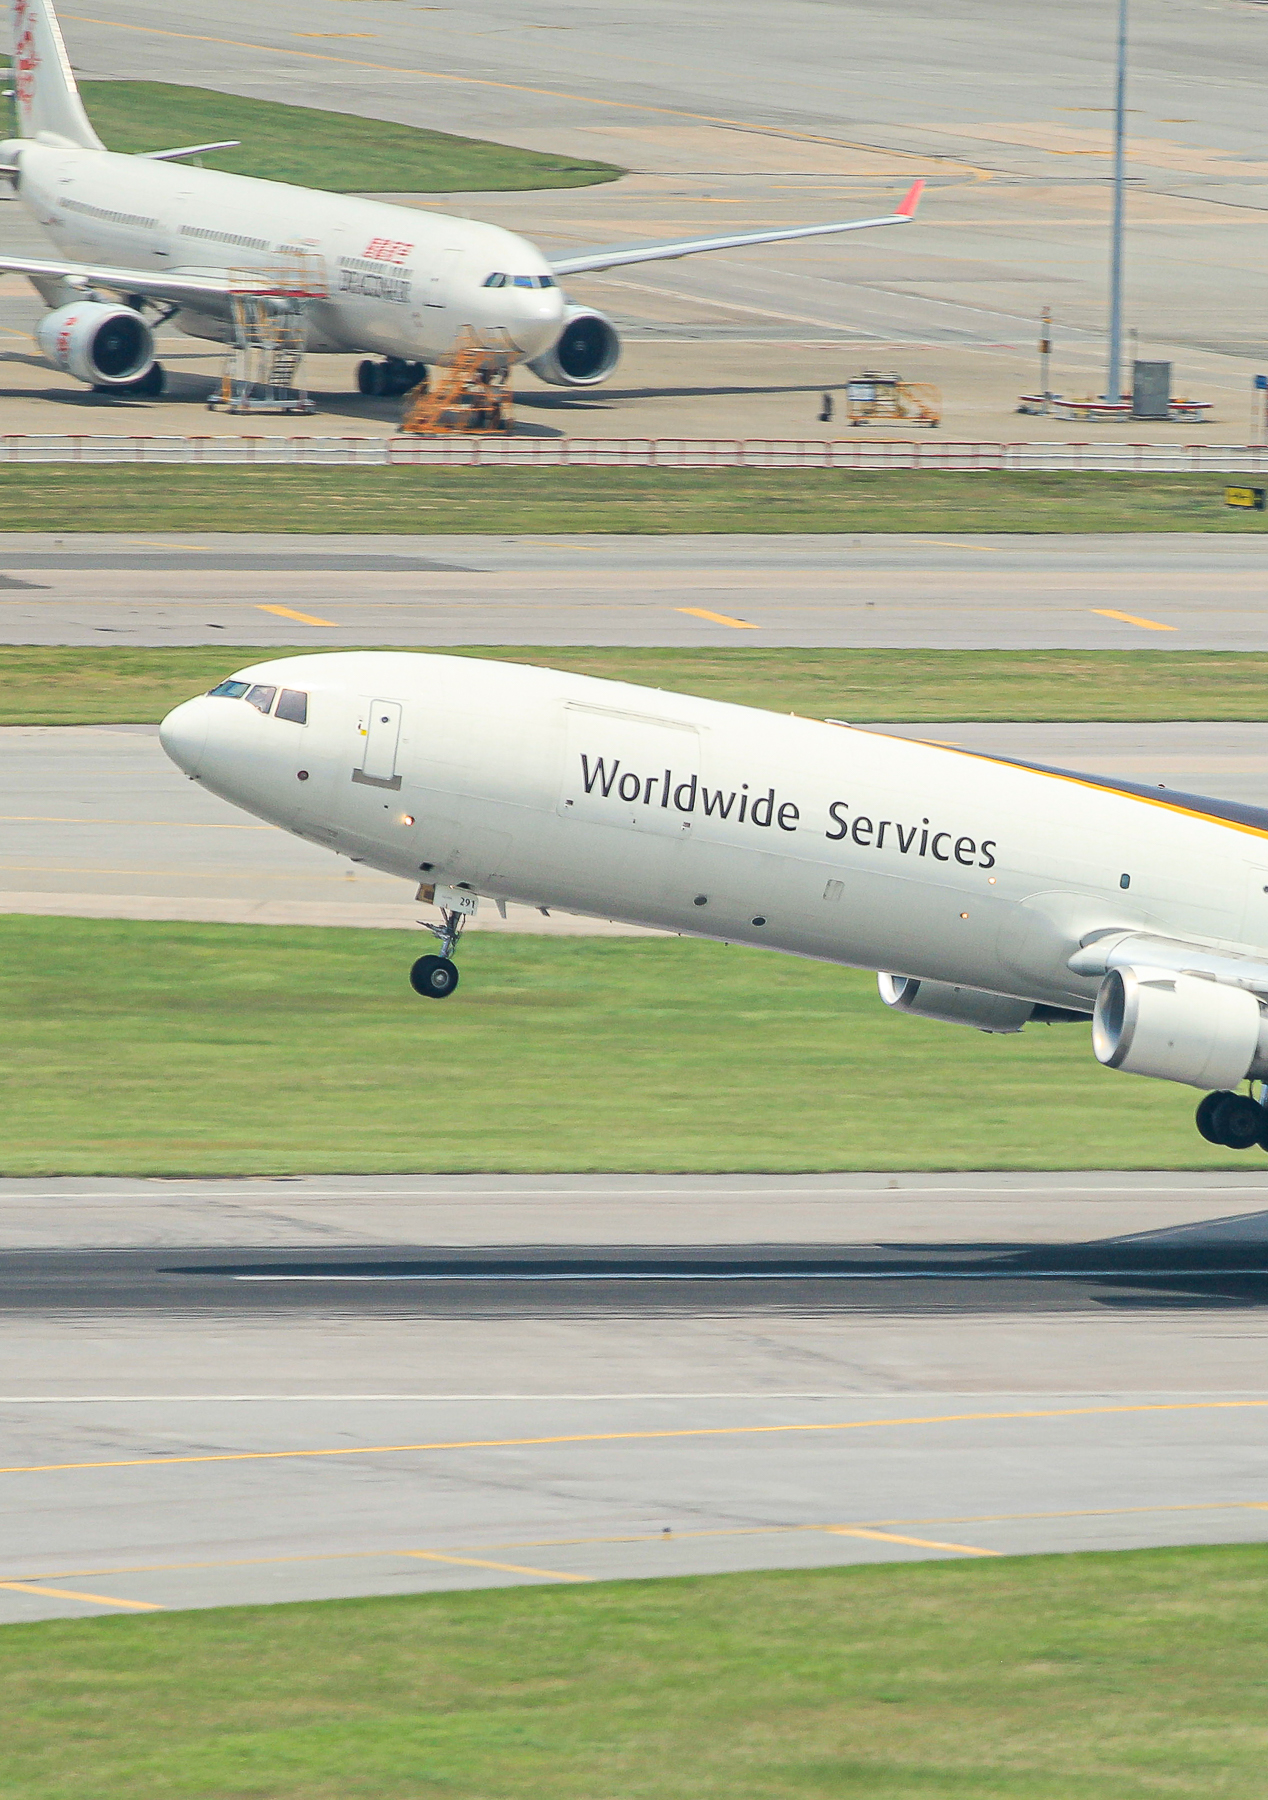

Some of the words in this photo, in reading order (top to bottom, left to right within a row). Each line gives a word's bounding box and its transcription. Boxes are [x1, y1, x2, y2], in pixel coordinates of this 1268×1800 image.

[580, 753, 800, 832] Worldwide
[825, 801, 997, 869] Services
[460, 896, 476, 909] 291
